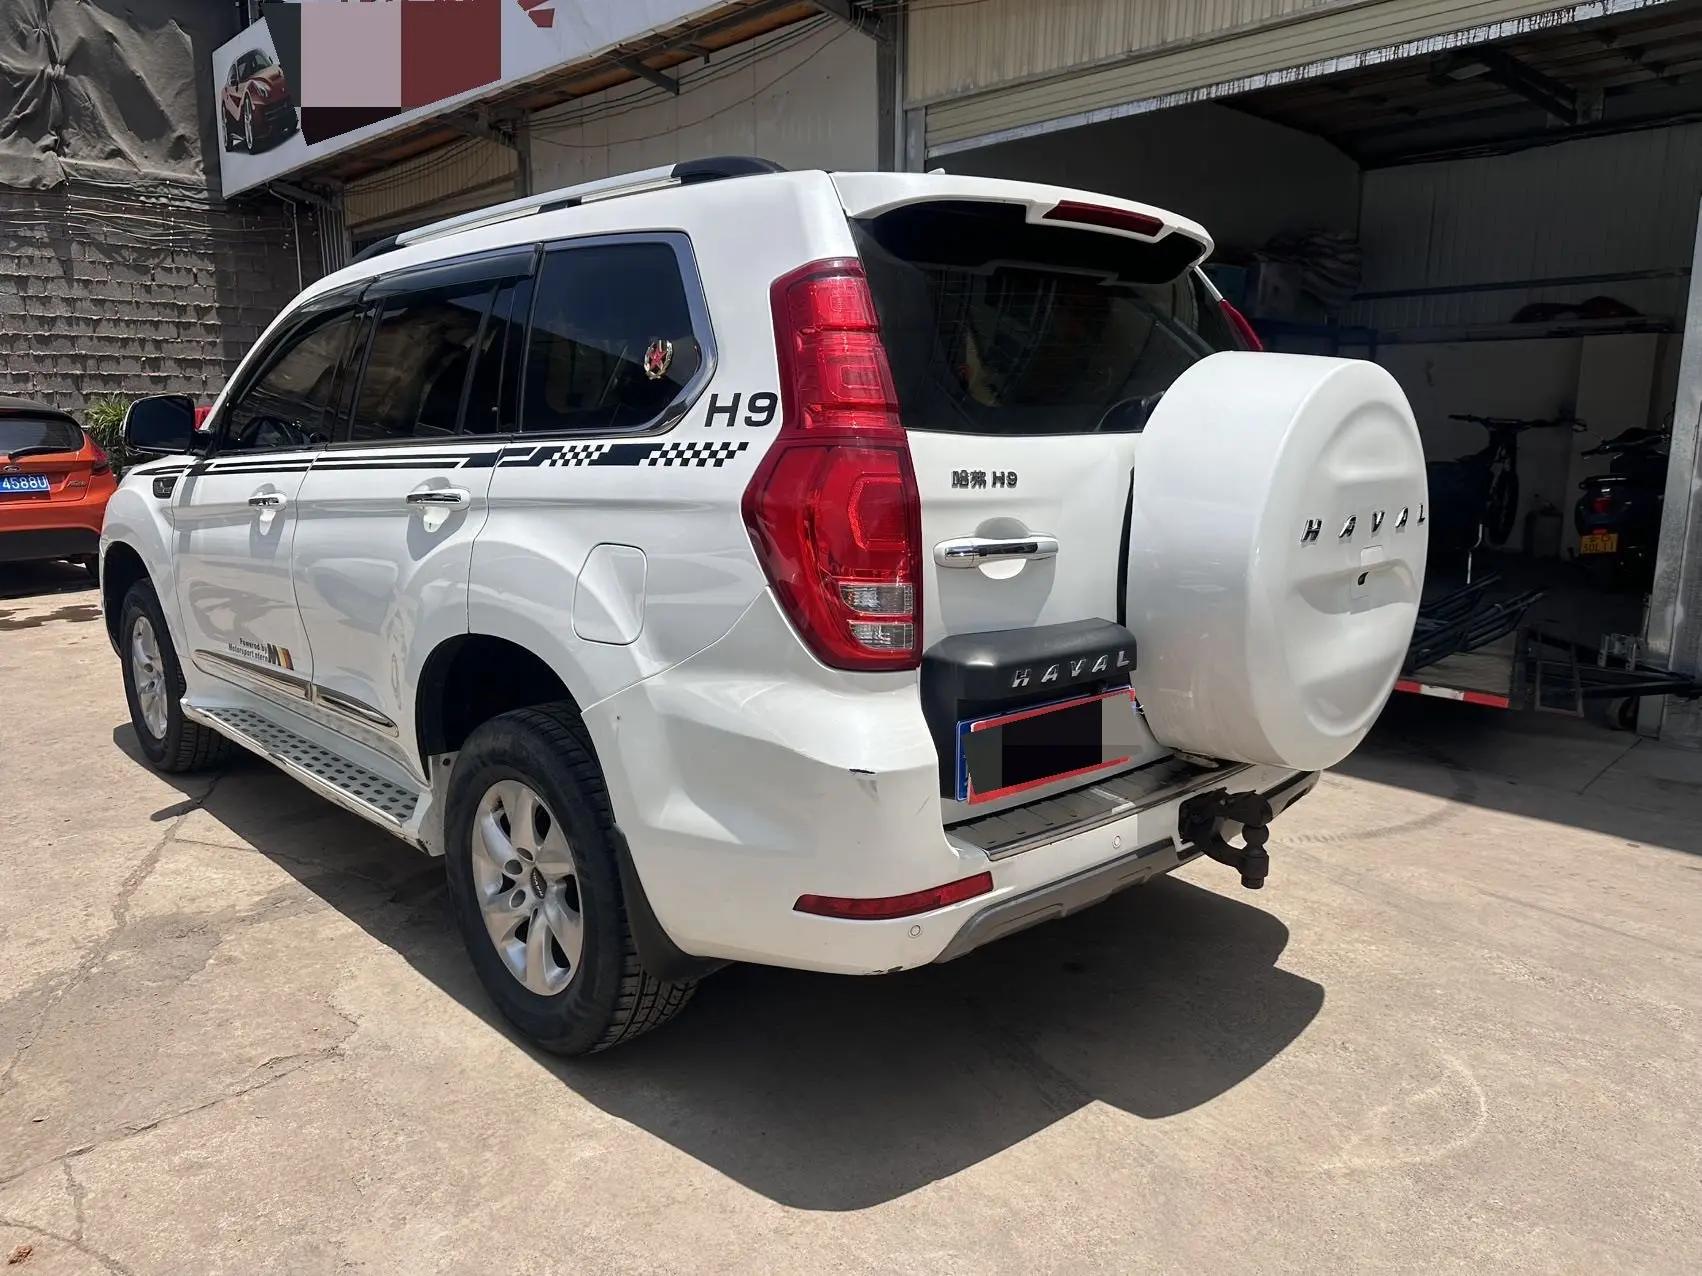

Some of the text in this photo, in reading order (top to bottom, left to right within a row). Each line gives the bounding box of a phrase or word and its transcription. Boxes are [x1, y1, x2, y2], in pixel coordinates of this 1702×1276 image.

[704, 392, 778, 427] H9
[2, 476, 47, 489] 4588U
[992, 471, 1018, 488] H9
[1301, 504, 1425, 542] HAVAL
[1011, 650, 1130, 688] HAVAL
